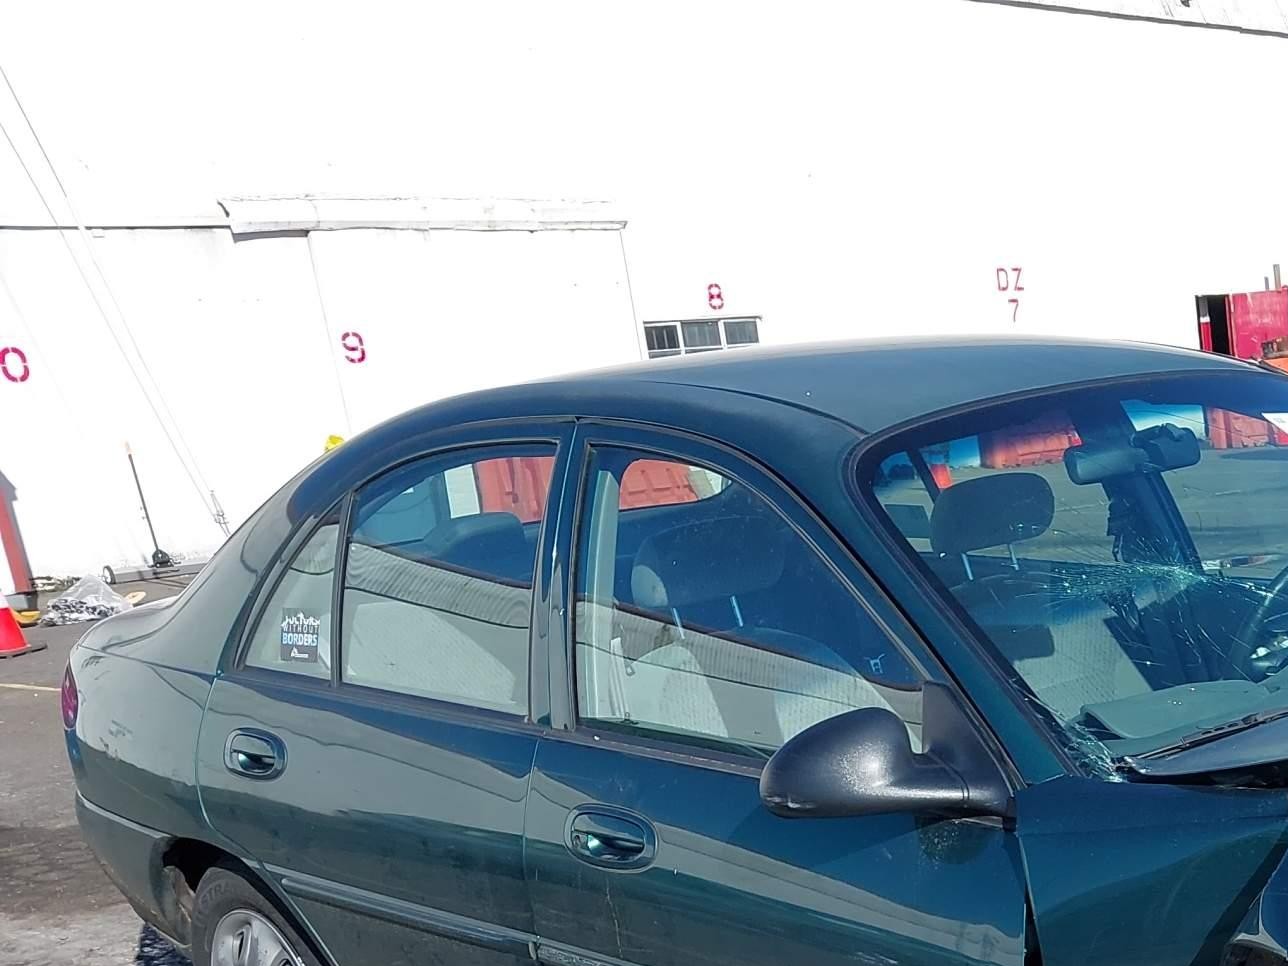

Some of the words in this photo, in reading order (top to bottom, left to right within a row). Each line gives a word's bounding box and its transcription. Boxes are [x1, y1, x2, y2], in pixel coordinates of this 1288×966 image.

[997, 268, 1024, 291] DZ
[708, 284, 724, 310] 8
[1008, 299, 1019, 322] 7
[342, 331, 366, 363] 9
[282, 633, 318, 646] BORDERS
[283, 624, 319, 633] WITHOUT
